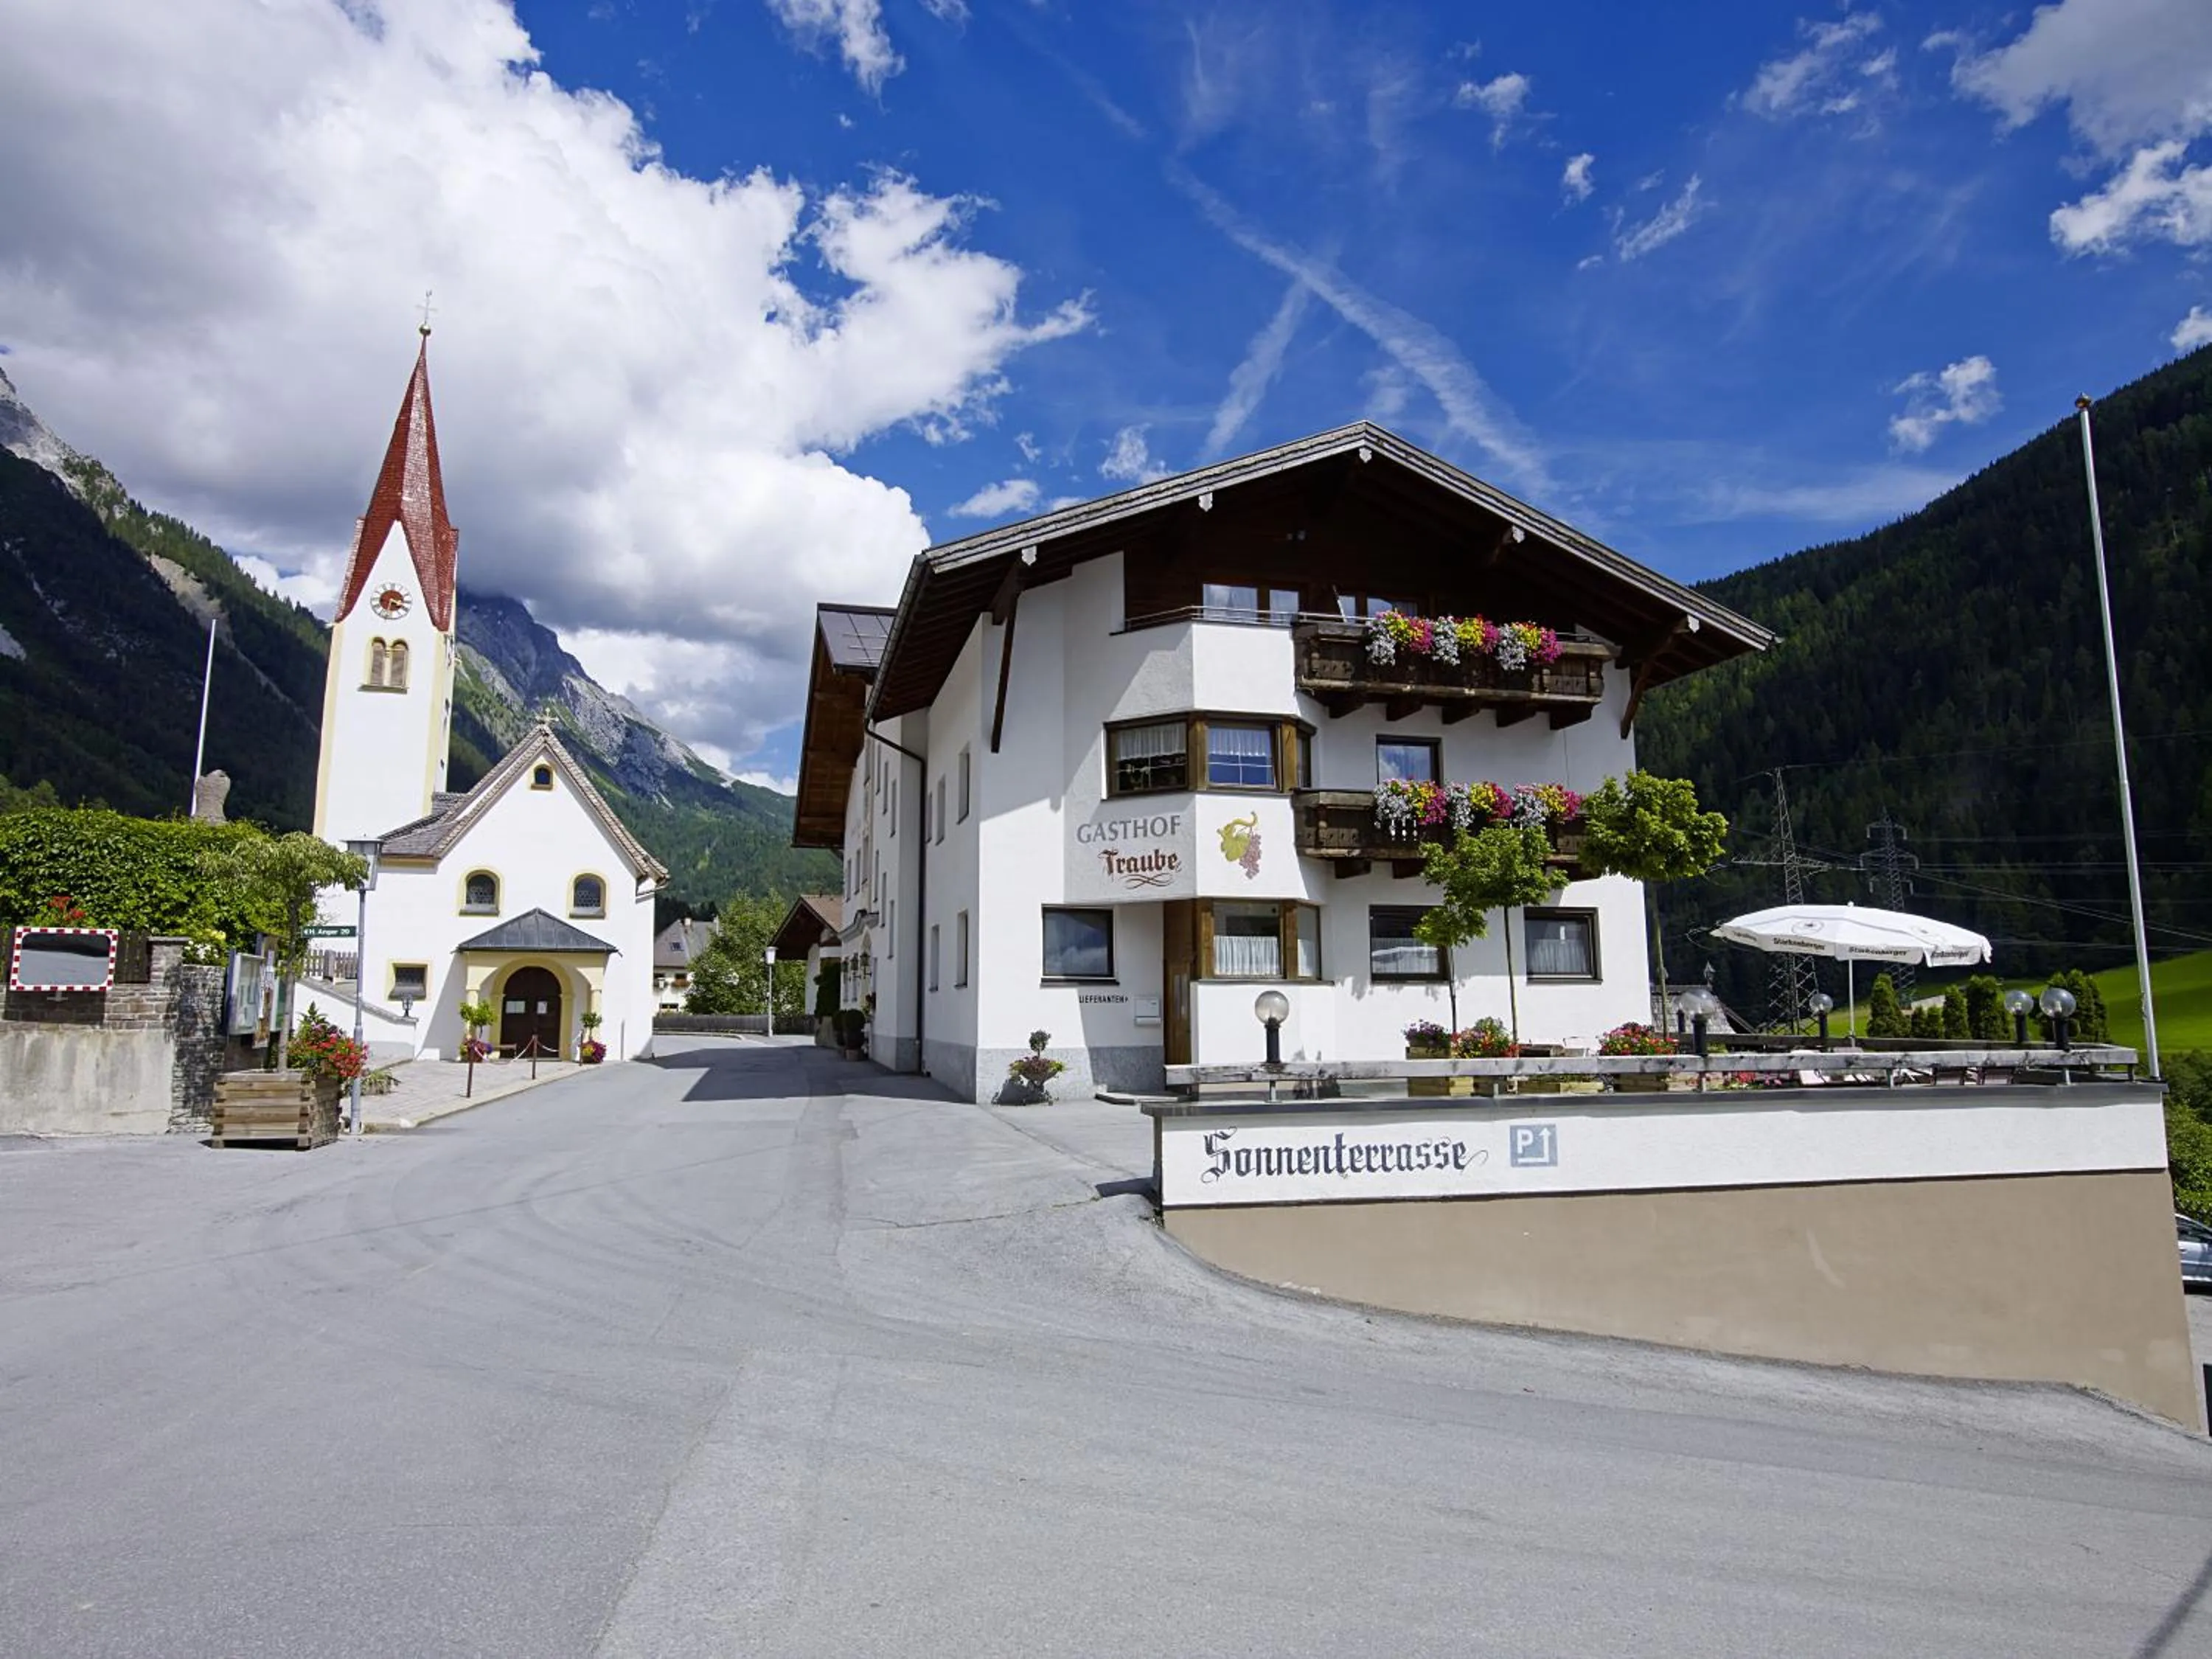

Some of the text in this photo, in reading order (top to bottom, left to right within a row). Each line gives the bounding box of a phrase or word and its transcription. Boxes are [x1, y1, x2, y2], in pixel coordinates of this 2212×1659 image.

[1077, 815, 1181, 844] GASTHOF
[1098, 848, 1182, 877] Traube
[1202, 1127, 1482, 1182] Sonnenterrasse
[1516, 1129, 1533, 1154] P
